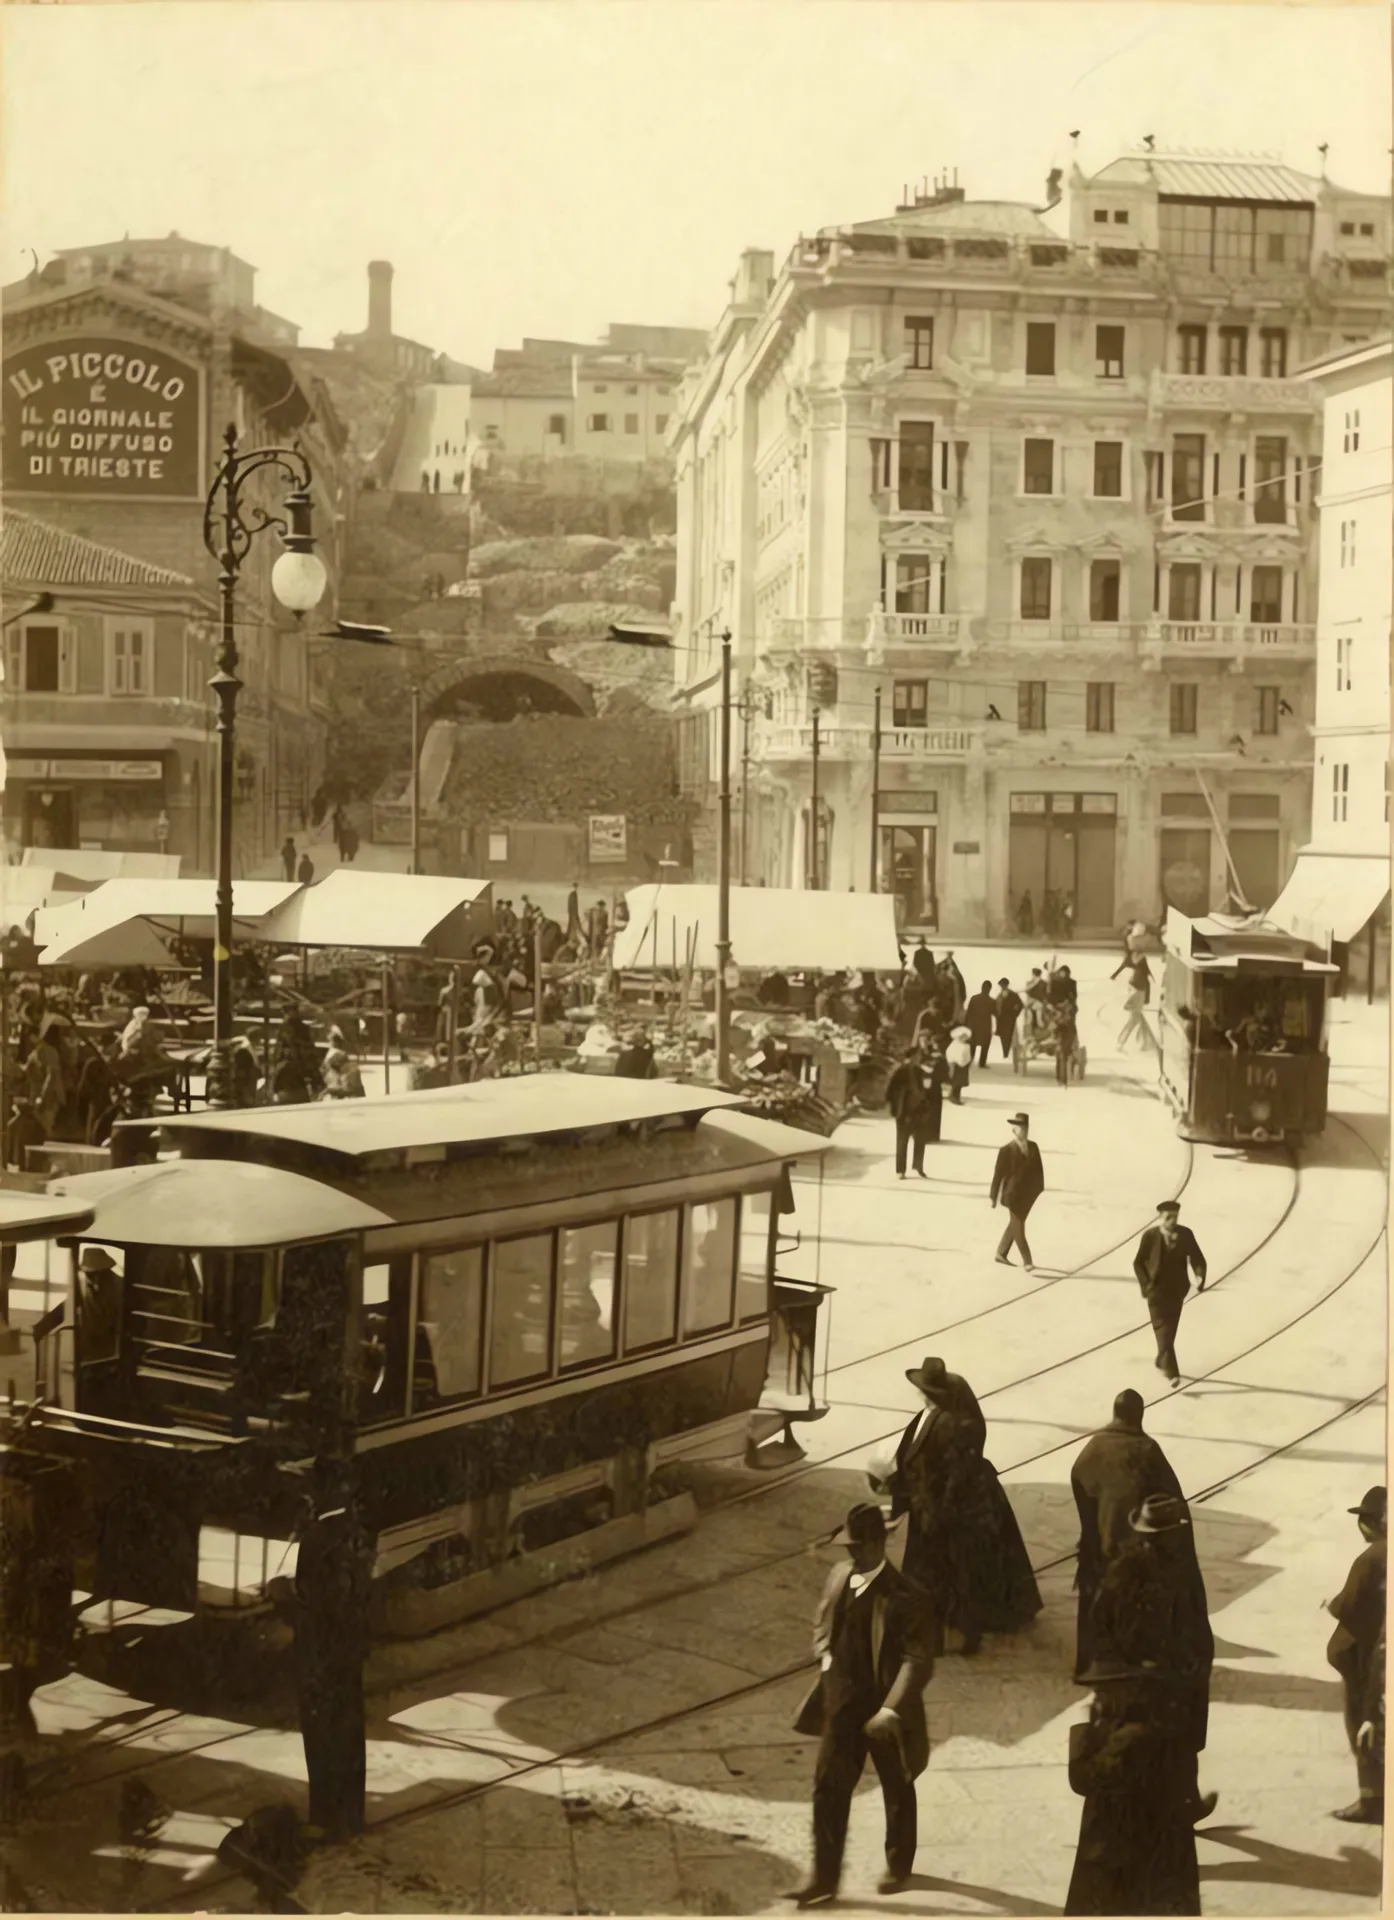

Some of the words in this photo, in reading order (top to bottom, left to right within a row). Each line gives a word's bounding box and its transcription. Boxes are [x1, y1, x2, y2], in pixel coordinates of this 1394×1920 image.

[9, 368, 43, 399] IL
[46, 352, 185, 401] PICCOLO
[22, 406, 44, 425] IL
[53, 408, 174, 429] GIORNALE
[70, 432, 173, 452] DIFFUSO
[30, 455, 52, 475] DI
[60, 456, 164, 478] TRIESTE
